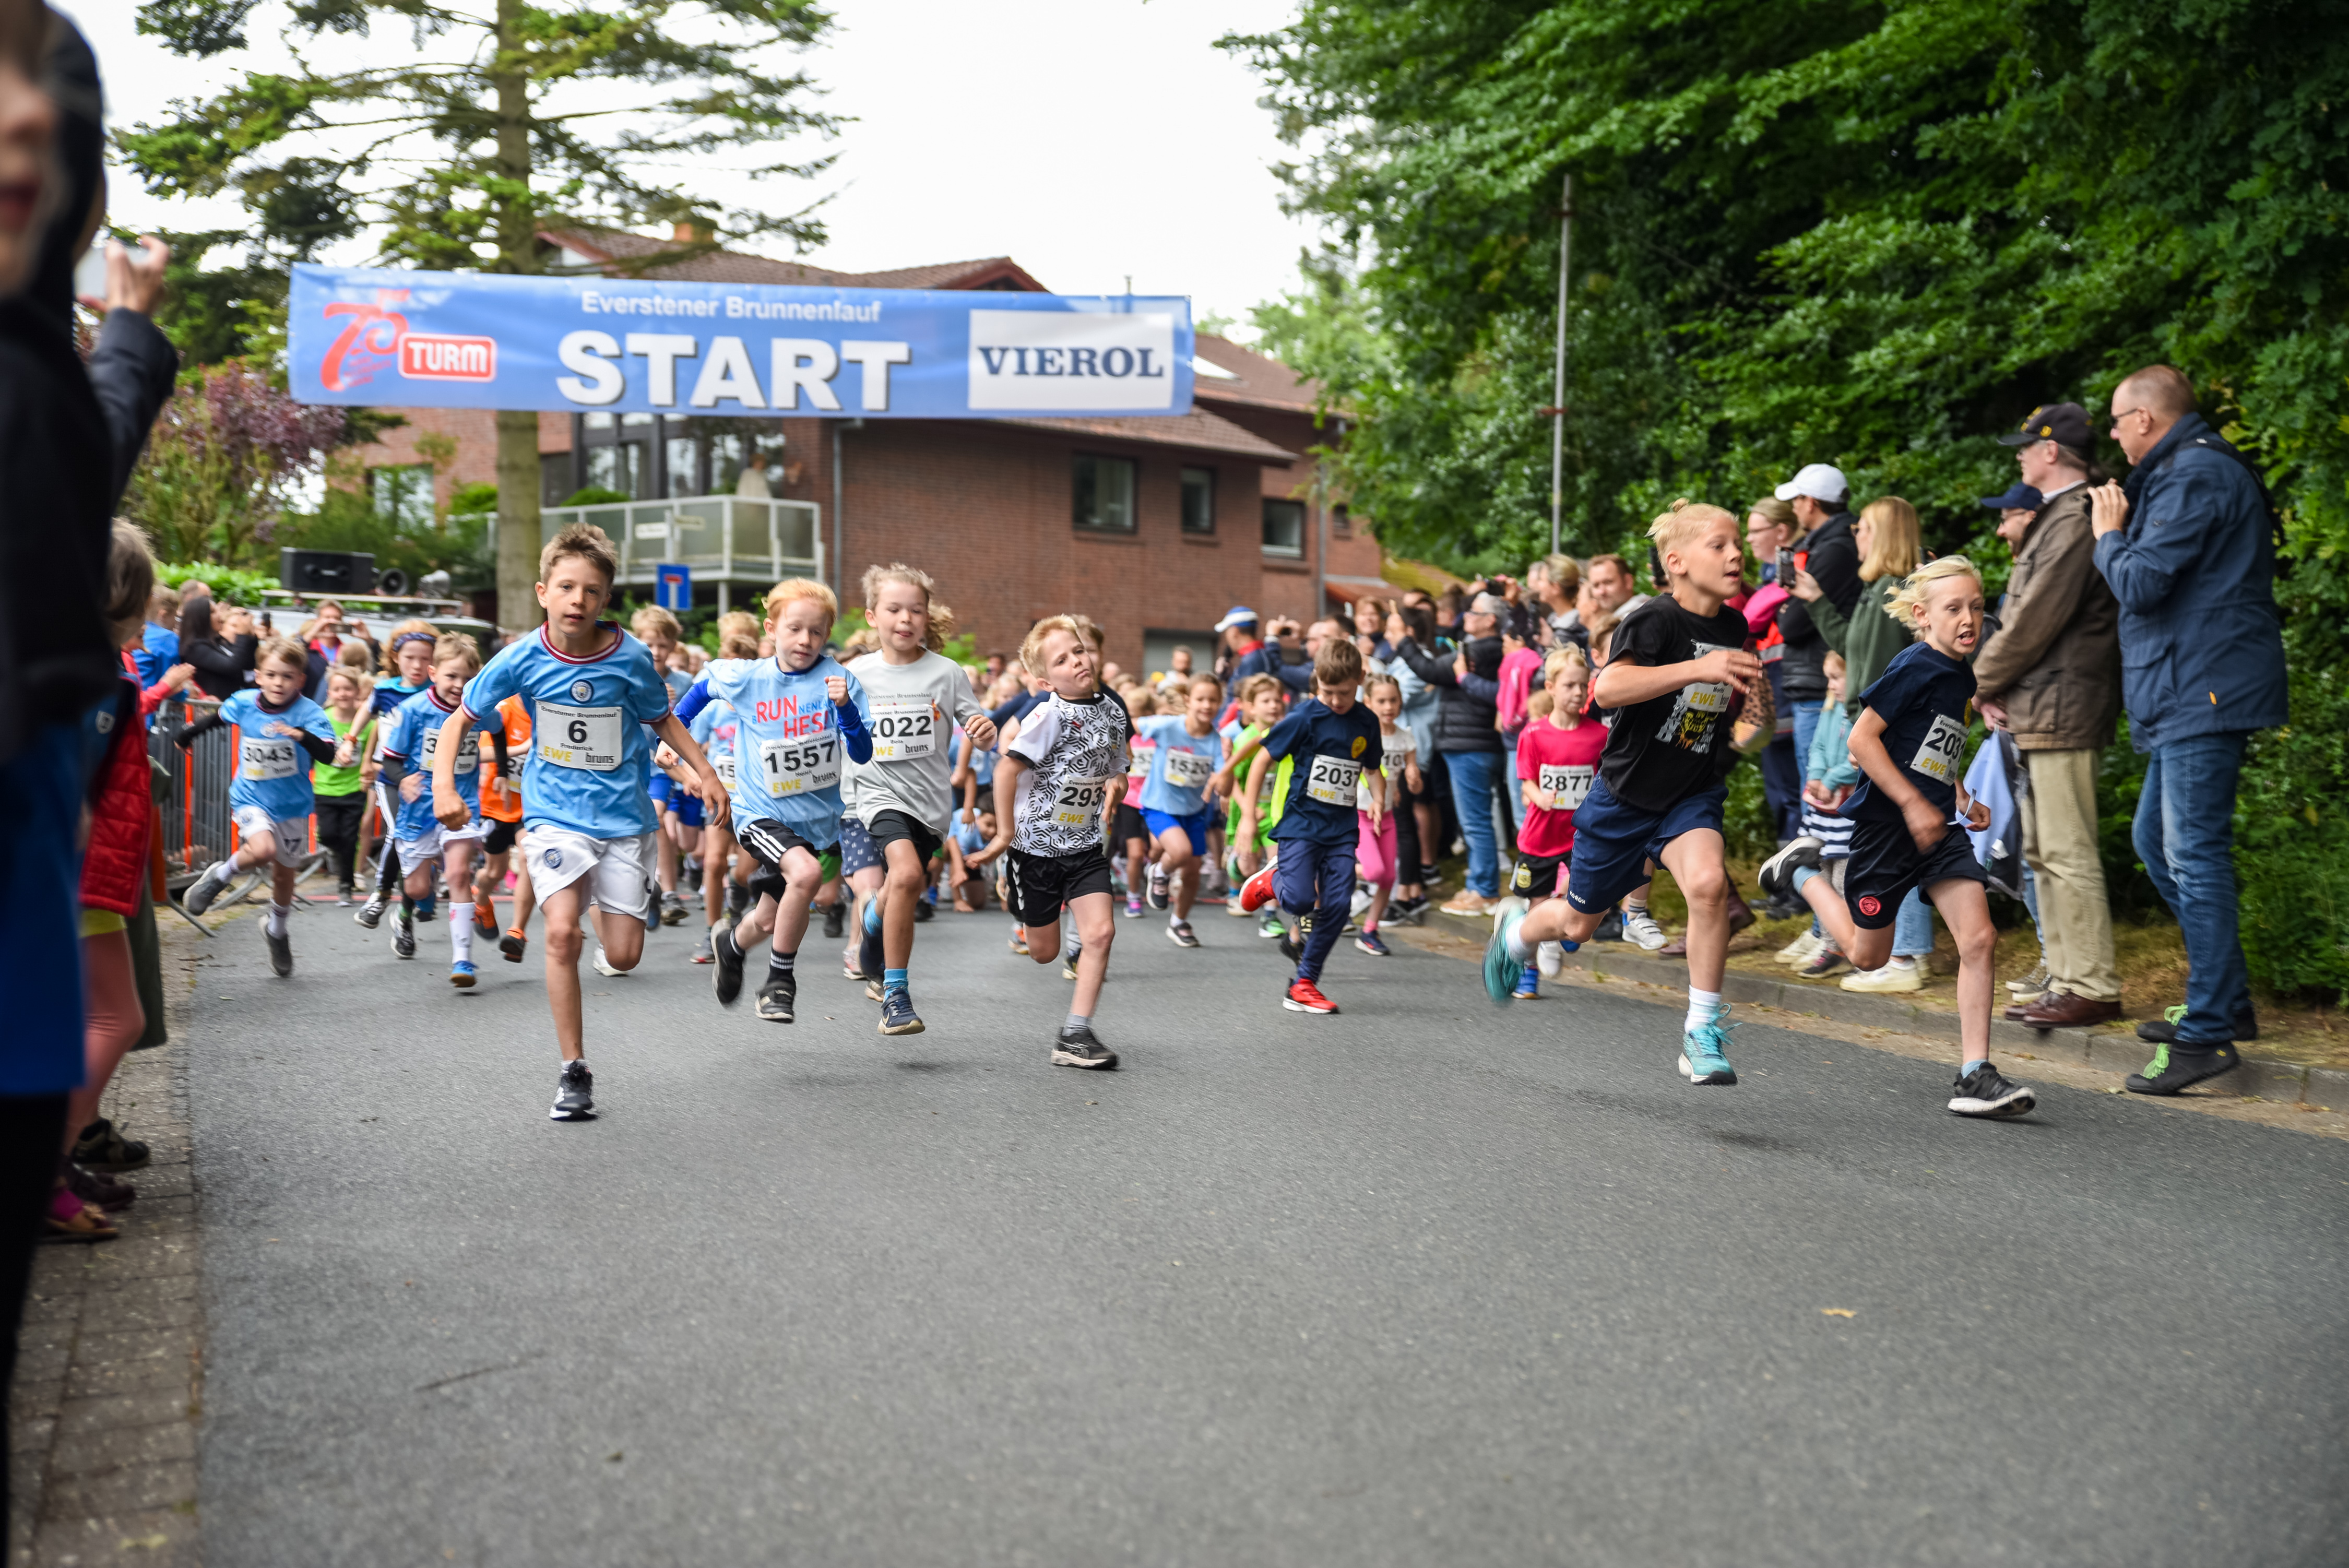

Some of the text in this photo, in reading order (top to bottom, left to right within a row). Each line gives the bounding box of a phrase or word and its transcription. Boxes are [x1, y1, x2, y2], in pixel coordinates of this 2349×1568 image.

[582, 290, 882, 322] Everstener Brunnenlauf
[408, 341, 487, 373] TURM
[977, 347, 1164, 377] VIEROL
[556, 329, 910, 411] START
[1690, 692, 1716, 706] EWE
[568, 720, 588, 743] 6
[544, 745, 573, 762] EWE
[873, 746, 894, 756] WE
[905, 744, 929, 753] bruns
[586, 752, 614, 763] bruns
[765, 740, 835, 774] 1557
[1921, 757, 1947, 775] EWE
[773, 779, 801, 793] EWE
[1543, 775, 1592, 791] 2877
[1313, 788, 1336, 800] EWE
[1059, 812, 1085, 824] EWE
